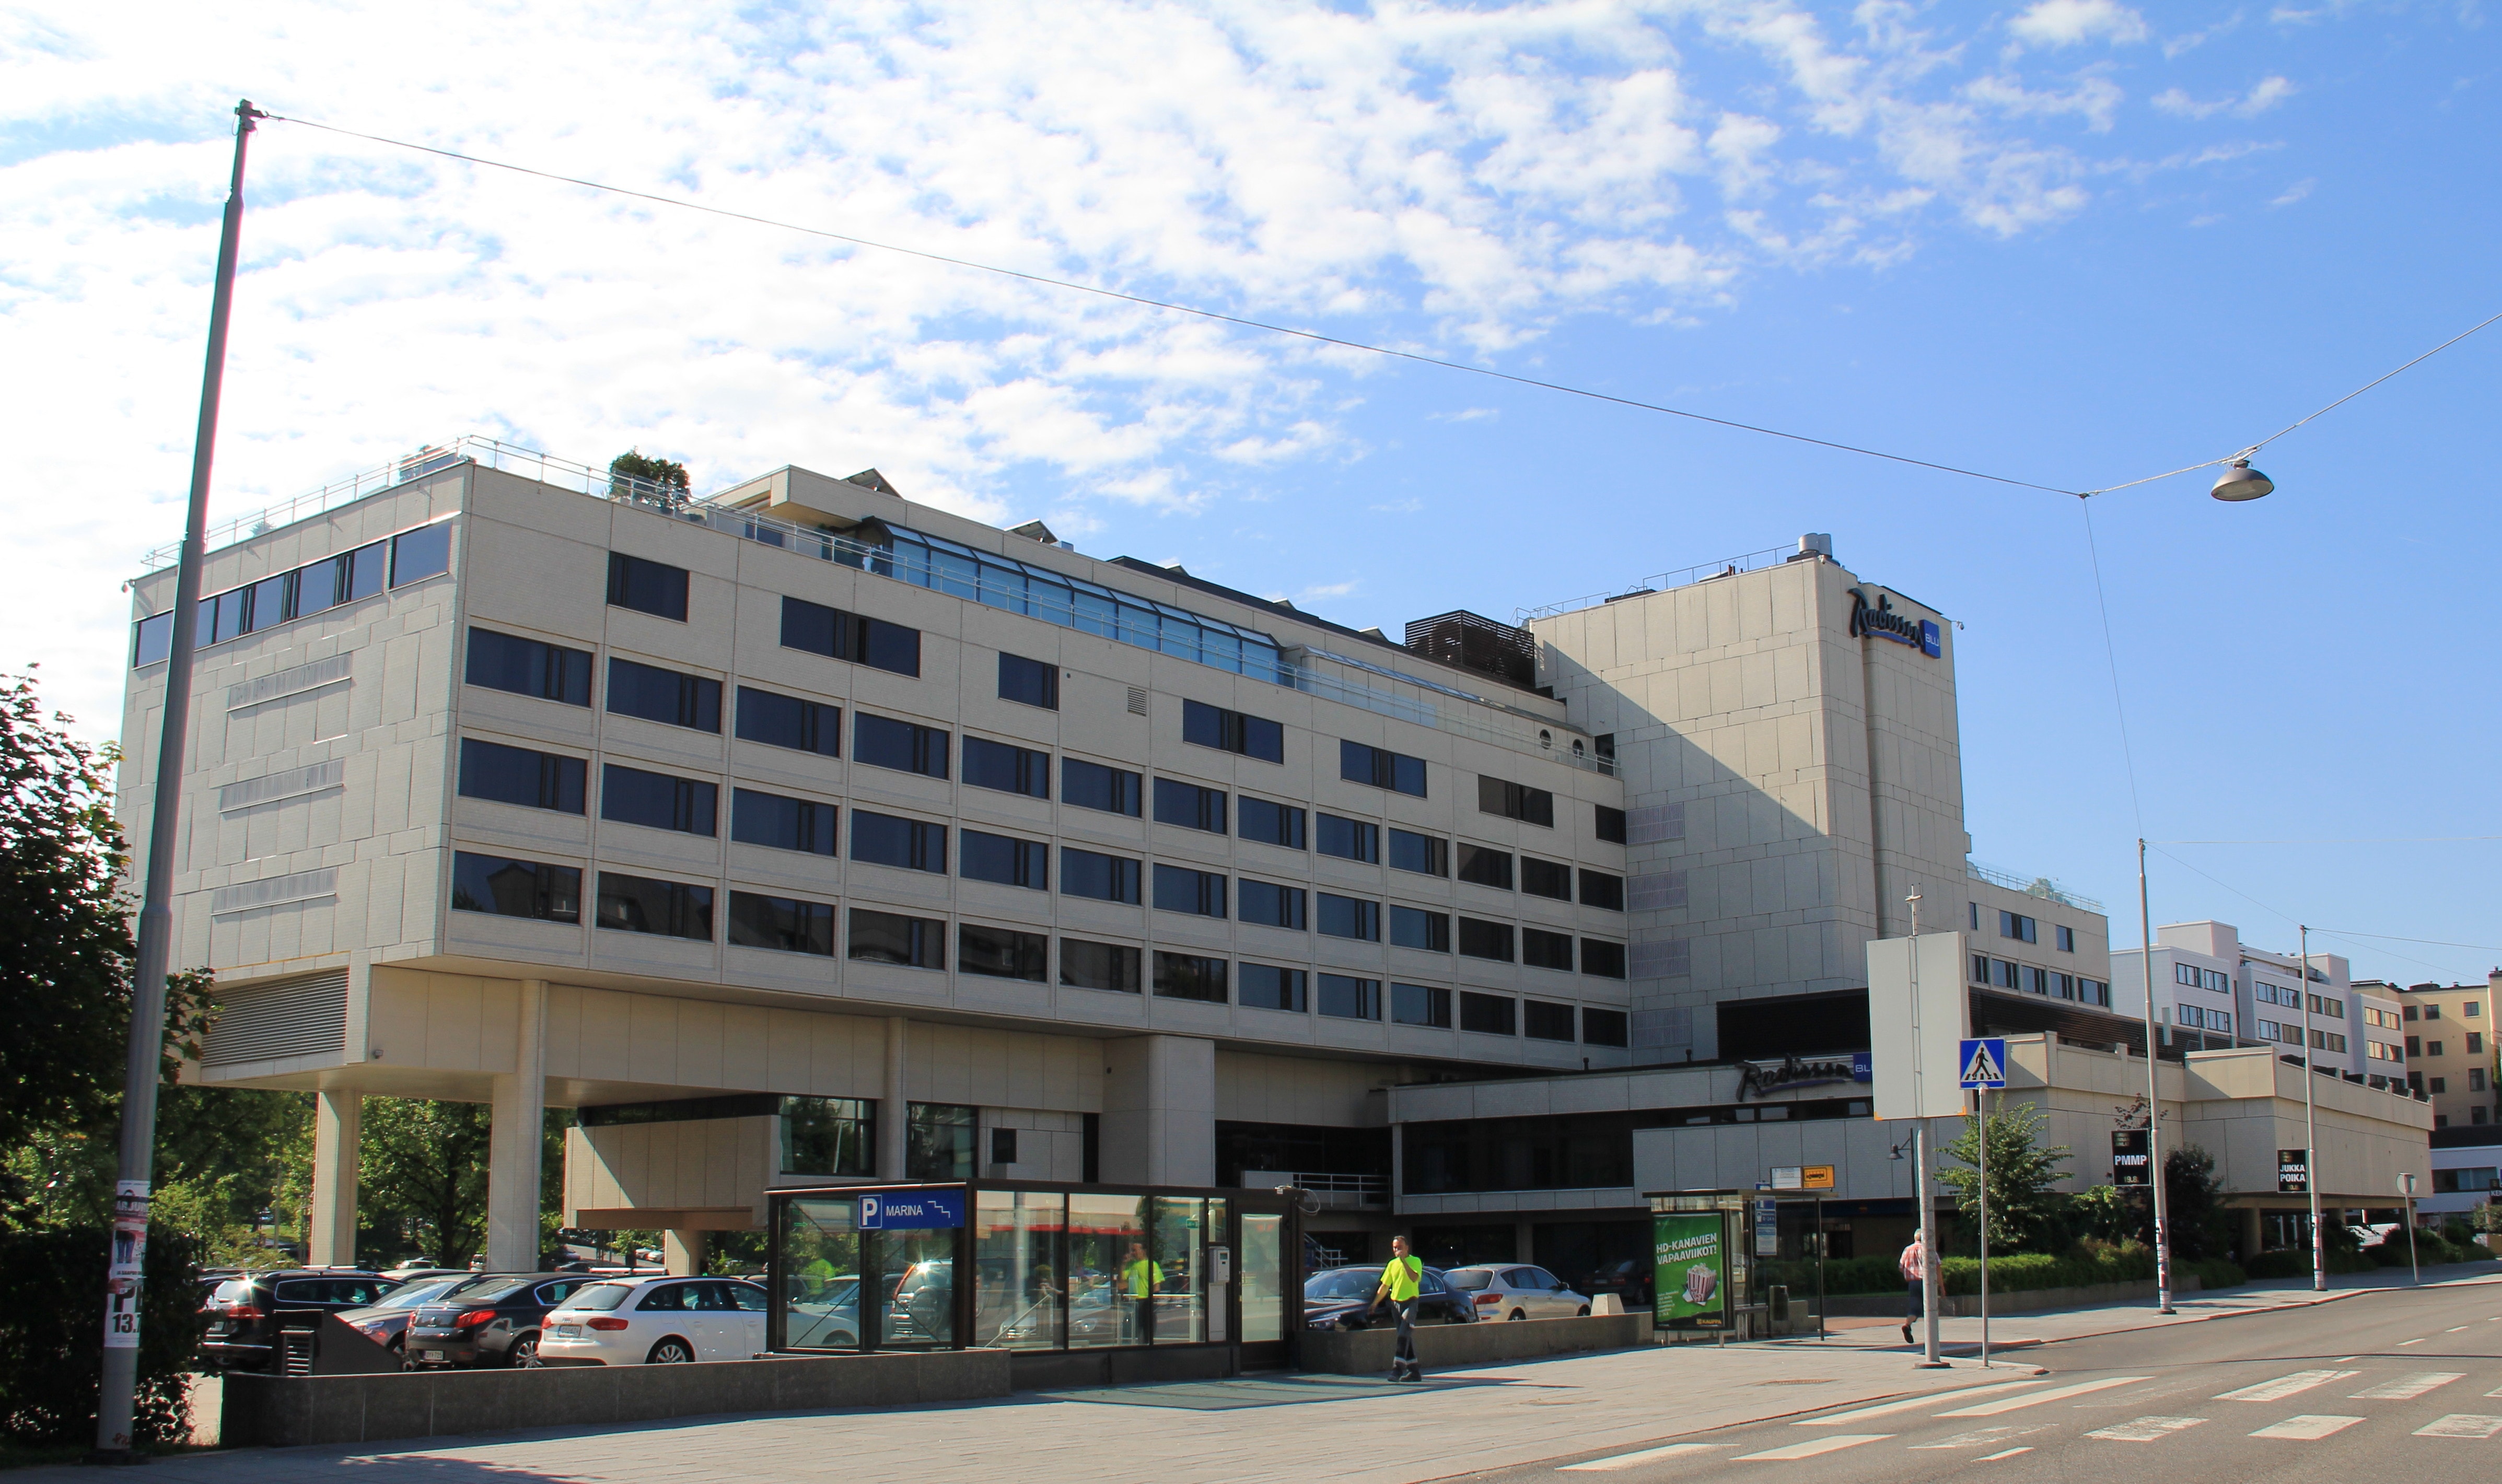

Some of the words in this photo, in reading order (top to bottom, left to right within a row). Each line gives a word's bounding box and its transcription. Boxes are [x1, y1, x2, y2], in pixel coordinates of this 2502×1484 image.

[1847, 587, 1924, 638] Radisson
[1925, 633, 1939, 646] BLU
[1735, 1053, 1854, 1102] Radisson
[1855, 1064, 1871, 1072] BL
[2114, 1155, 2147, 1165] PMMP
[863, 1198, 878, 1225] P
[886, 1205, 923, 1216] MARINA
[1656, 1233, 1717, 1253] HD-KANAVIEN
[1657, 1245, 1717, 1265] VAPAAVIIKOT!
